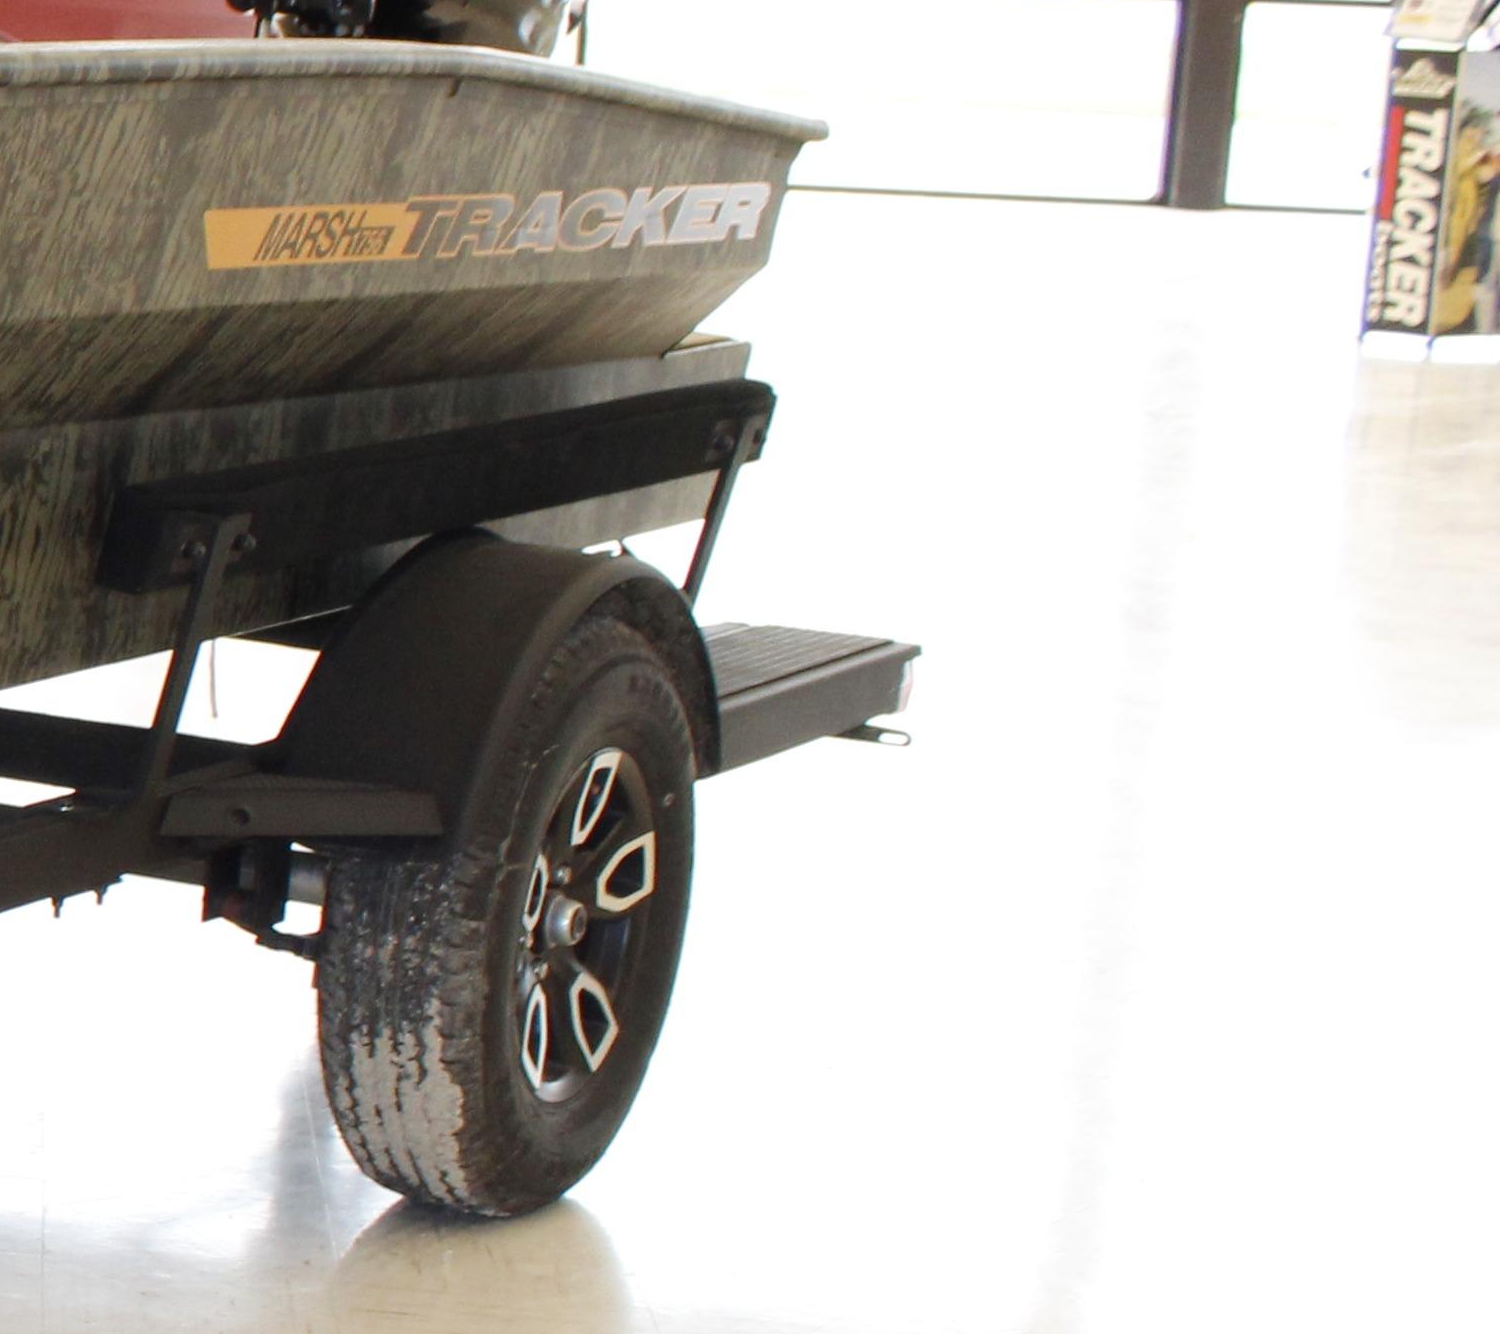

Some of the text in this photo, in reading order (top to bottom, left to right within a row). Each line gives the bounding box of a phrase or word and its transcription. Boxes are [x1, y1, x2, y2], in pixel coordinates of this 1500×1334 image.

[253, 209, 368, 261] MARSH
[401, 181, 771, 261] TRACKER
[1383, 107, 1450, 329] TRACKER
